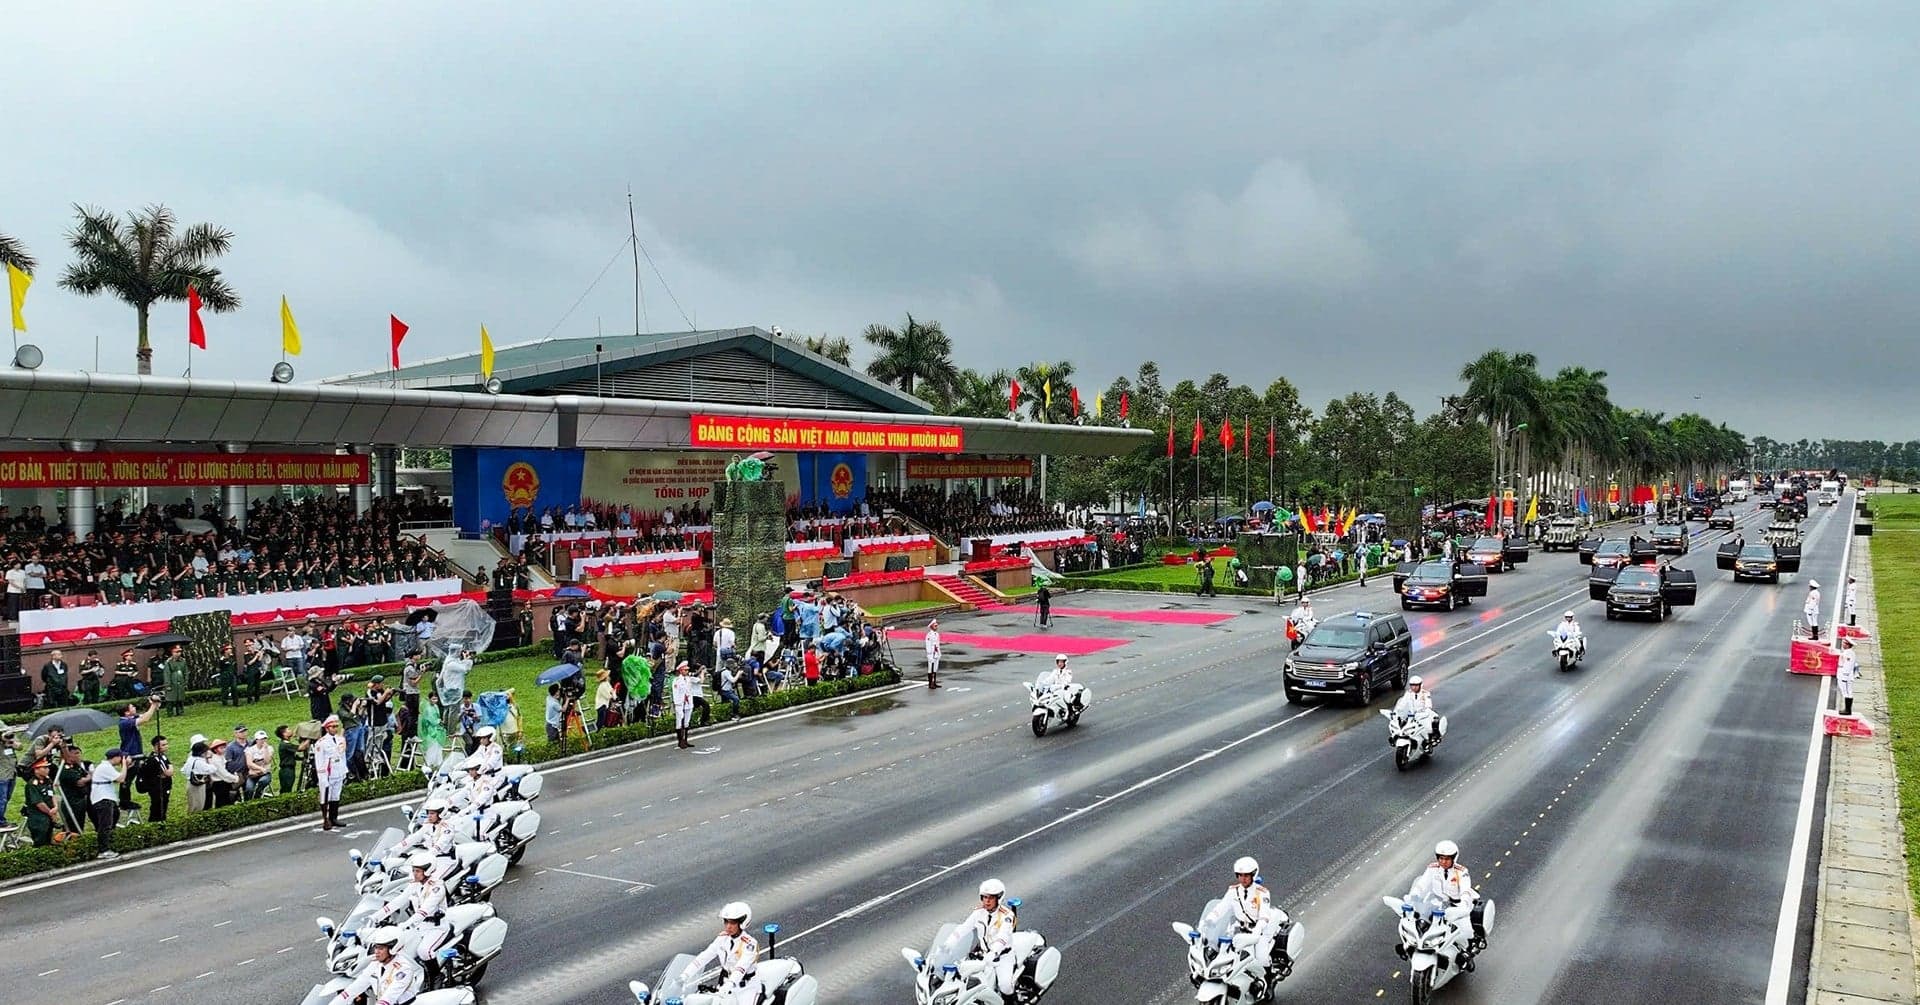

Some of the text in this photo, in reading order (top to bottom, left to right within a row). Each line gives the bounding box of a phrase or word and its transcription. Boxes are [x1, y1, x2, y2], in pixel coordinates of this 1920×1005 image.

[698, 418, 958, 448] ĐẢNG CỘNG SẢN VIỆT NAM QUANG VINH MUÔN NĂM
[1, 460, 16, 481] CƠ
[19, 457, 46, 484] BẢN,
[49, 457, 78, 481] THIẾT
[80, 459, 110, 484] THỰC,
[178, 460, 196, 483] LỰC
[198, 460, 228, 483] LƯỢNG
[654, 484, 710, 499] TỔNG HỢP
